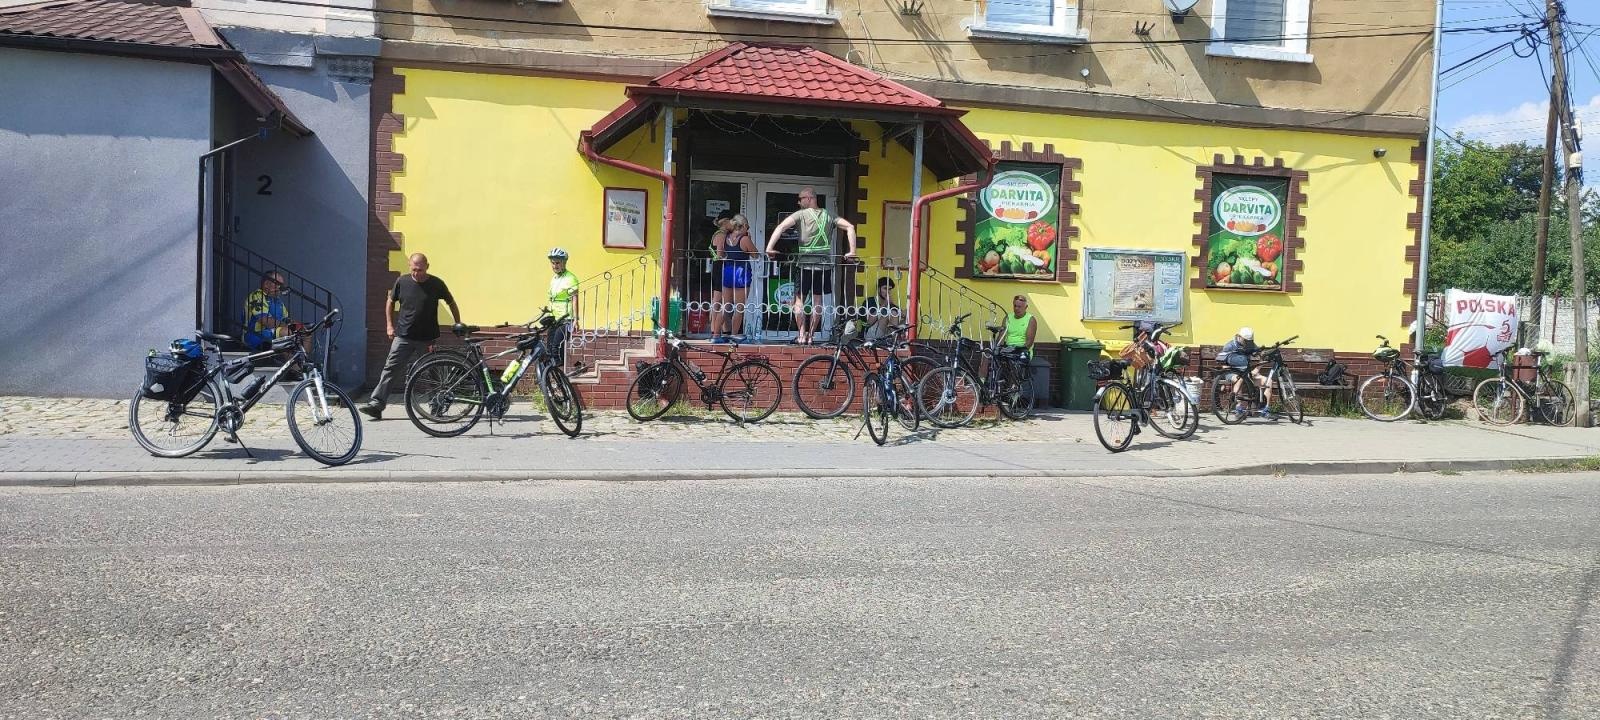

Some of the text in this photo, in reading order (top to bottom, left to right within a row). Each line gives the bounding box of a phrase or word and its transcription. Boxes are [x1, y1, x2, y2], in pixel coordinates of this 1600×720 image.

[257, 175, 272, 195] 2
[991, 188, 1044, 202] DARVITA
[1223, 202, 1272, 215] DARVITA
[1456, 299, 1515, 317] POLSKA
